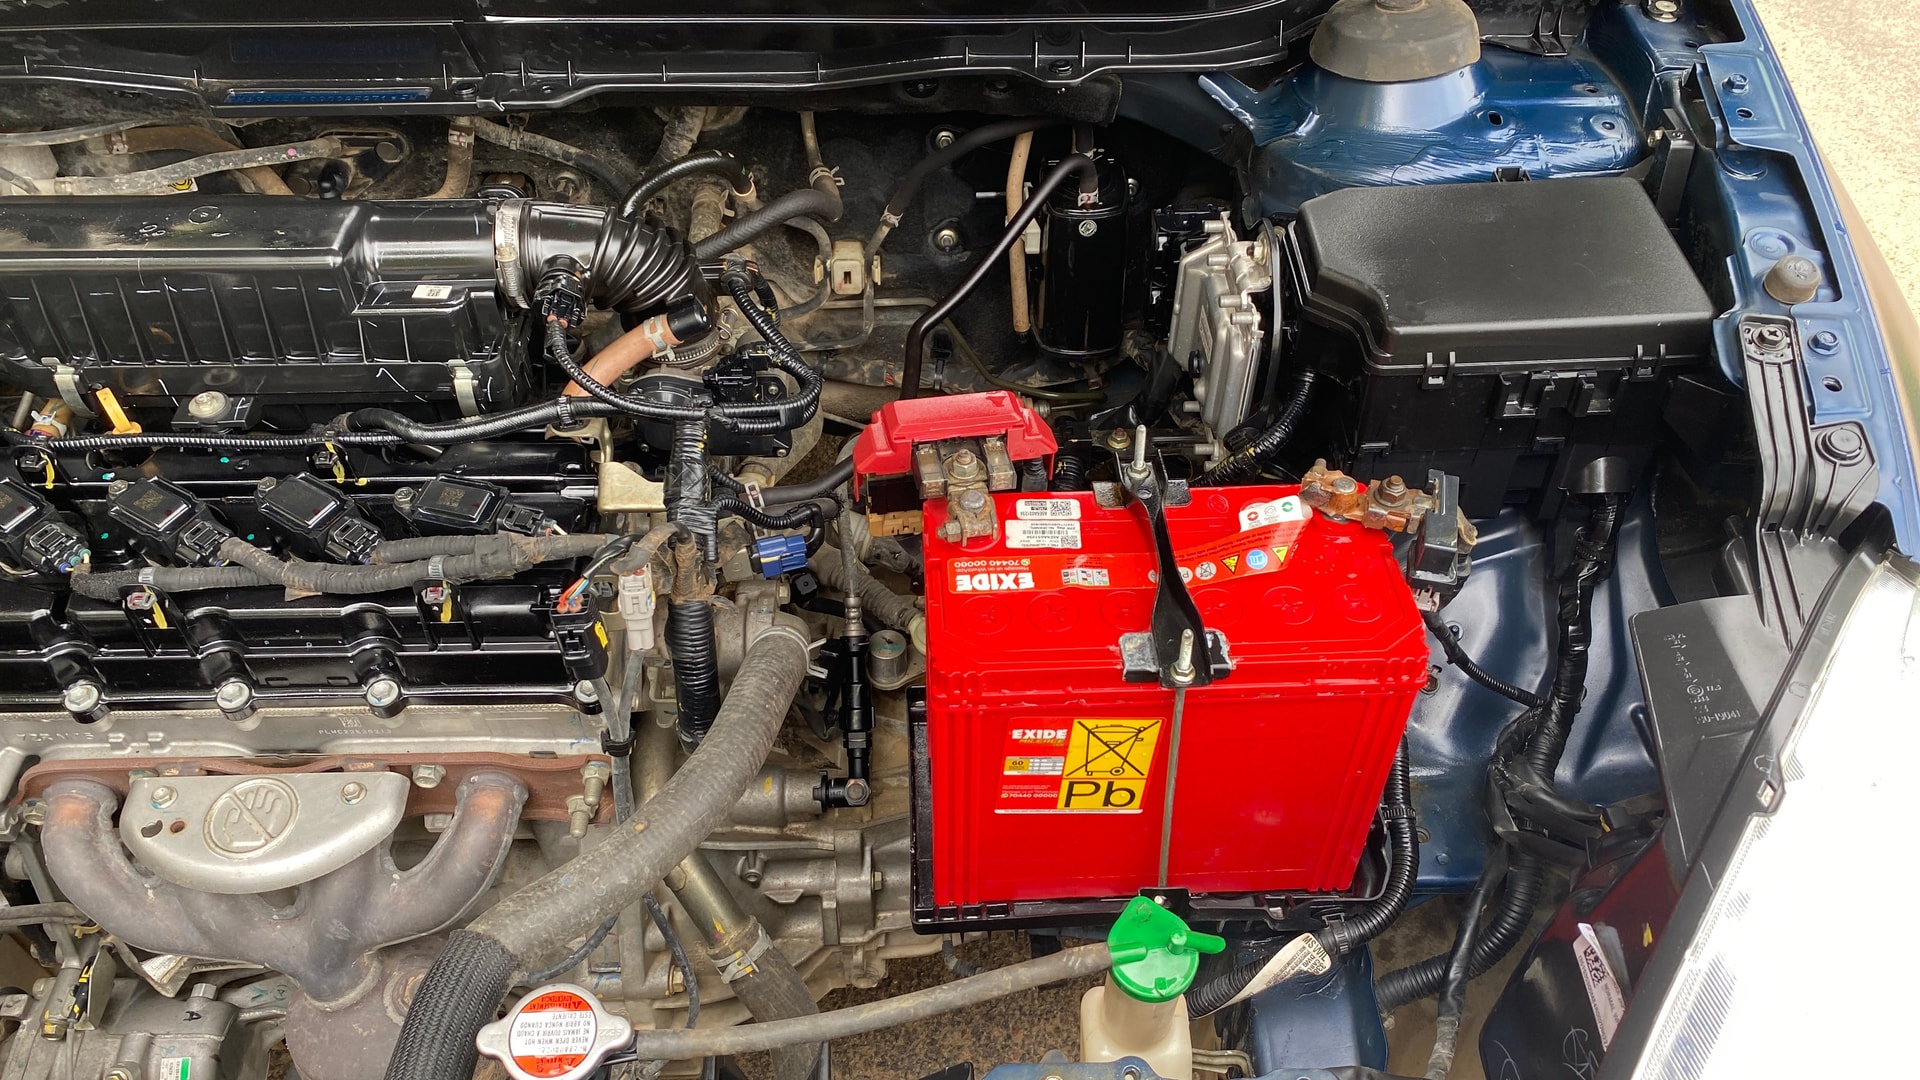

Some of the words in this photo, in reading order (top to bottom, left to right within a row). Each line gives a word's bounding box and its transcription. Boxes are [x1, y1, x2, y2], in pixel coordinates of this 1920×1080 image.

[956, 572, 1034, 591] EXIDE
[1011, 729, 1068, 739] EXIDE
[1064, 780, 1136, 808] Pb
[1303, 935, 1328, 962] MSWIL
